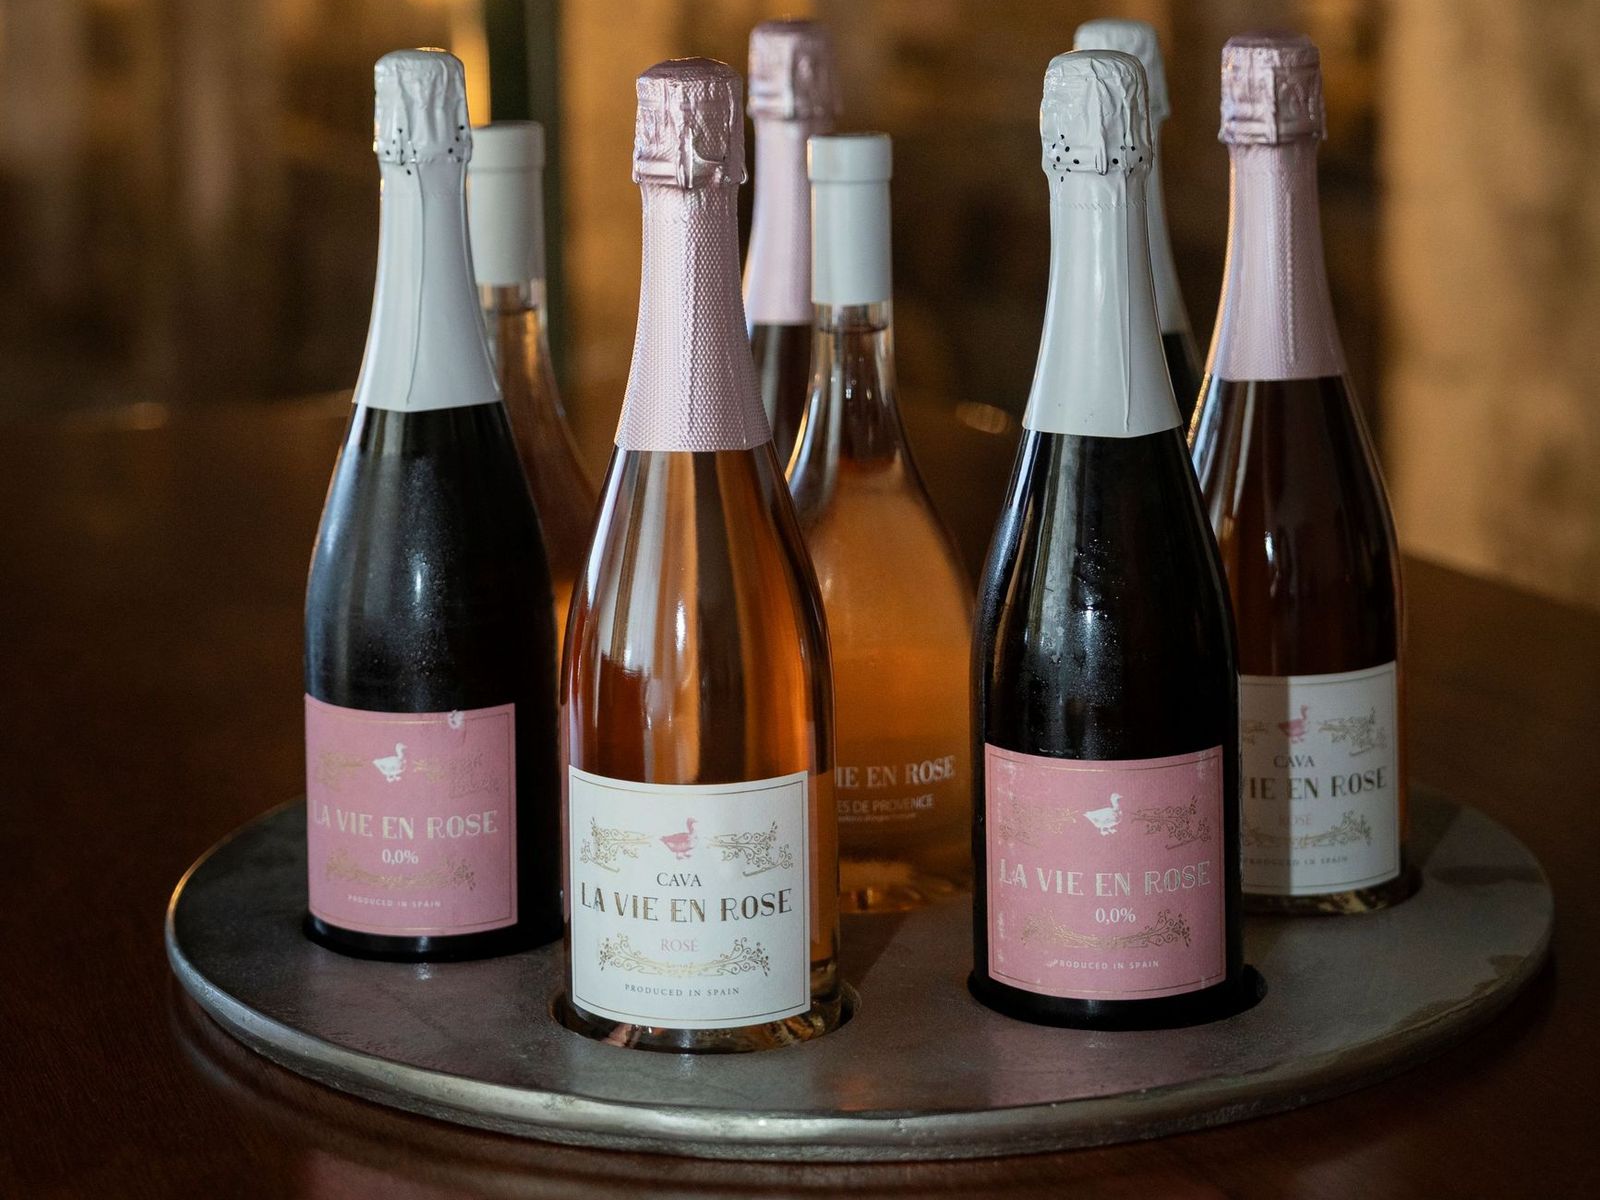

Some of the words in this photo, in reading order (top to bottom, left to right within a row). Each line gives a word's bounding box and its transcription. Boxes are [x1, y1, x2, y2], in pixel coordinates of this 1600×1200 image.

[1273, 755, 1316, 768] CAVA
[837, 766, 859, 788] IE
[867, 766, 897, 787] EN
[906, 755, 956, 785] ROSE
[1248, 777, 1276, 800] IE
[1289, 777, 1319, 800] EN
[1331, 766, 1388, 797] ROSE
[872, 794, 935, 813] PROVENCE
[312, 800, 332, 828] LA
[336, 809, 373, 838] VIE
[382, 816, 414, 839] EN
[427, 810, 498, 839] ROSE
[382, 849, 419, 864] 0,0%
[656, 872, 702, 887] CAVA
[999, 859, 1028, 889] LA
[1036, 867, 1085, 896] VIE
[1095, 872, 1131, 897] EN
[1144, 861, 1211, 896] ROSE
[411, 900, 441, 908] SPAIN
[581, 882, 606, 912] LA
[614, 891, 658, 921] VIE
[670, 898, 706, 923] EN
[720, 888, 793, 922] ROSE
[1095, 907, 1136, 925] 0,0%
[1054, 959, 1108, 969] PRODUCED
[1113, 961, 1125, 969] IN
[1129, 960, 1159, 969] SPAIN
[625, 984, 683, 997] PRODUCED
[688, 989, 701, 997] IN
[707, 987, 740, 997] SPAIN
